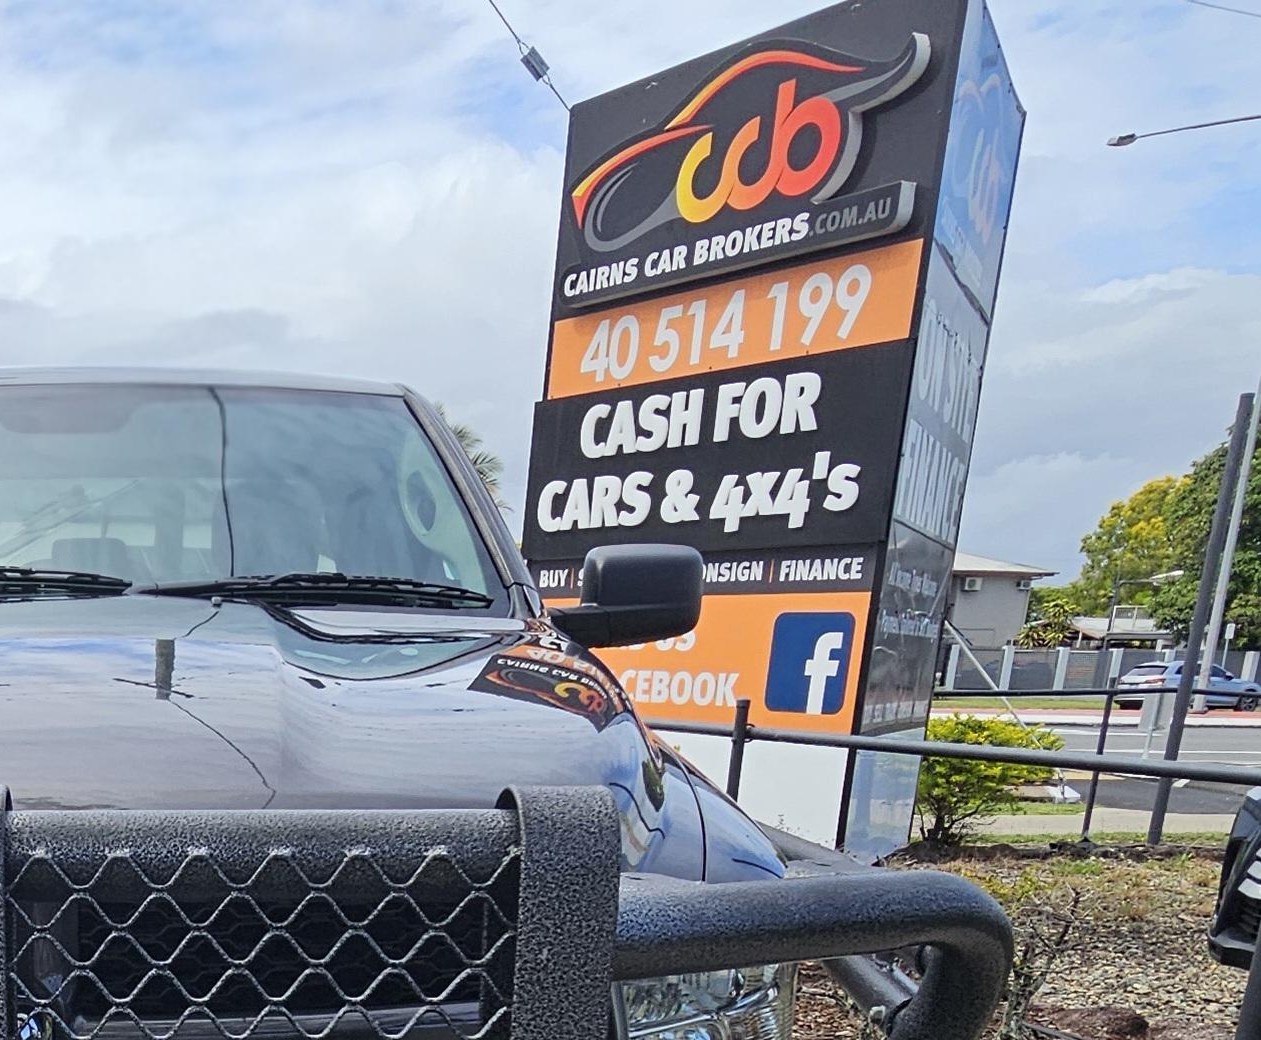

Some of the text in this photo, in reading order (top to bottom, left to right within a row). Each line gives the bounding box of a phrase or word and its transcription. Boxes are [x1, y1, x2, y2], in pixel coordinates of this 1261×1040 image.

[563, 258, 638, 297] CAIRNS
[644, 245, 688, 277] CAR
[580, 264, 872, 383] 40 514 199
[580, 372, 822, 458] CASH FOR
[537, 471, 654, 533] CARS
[660, 469, 700, 523] &
[539, 568, 568, 588] BUY
[778, 556, 864, 583] FINANCE
